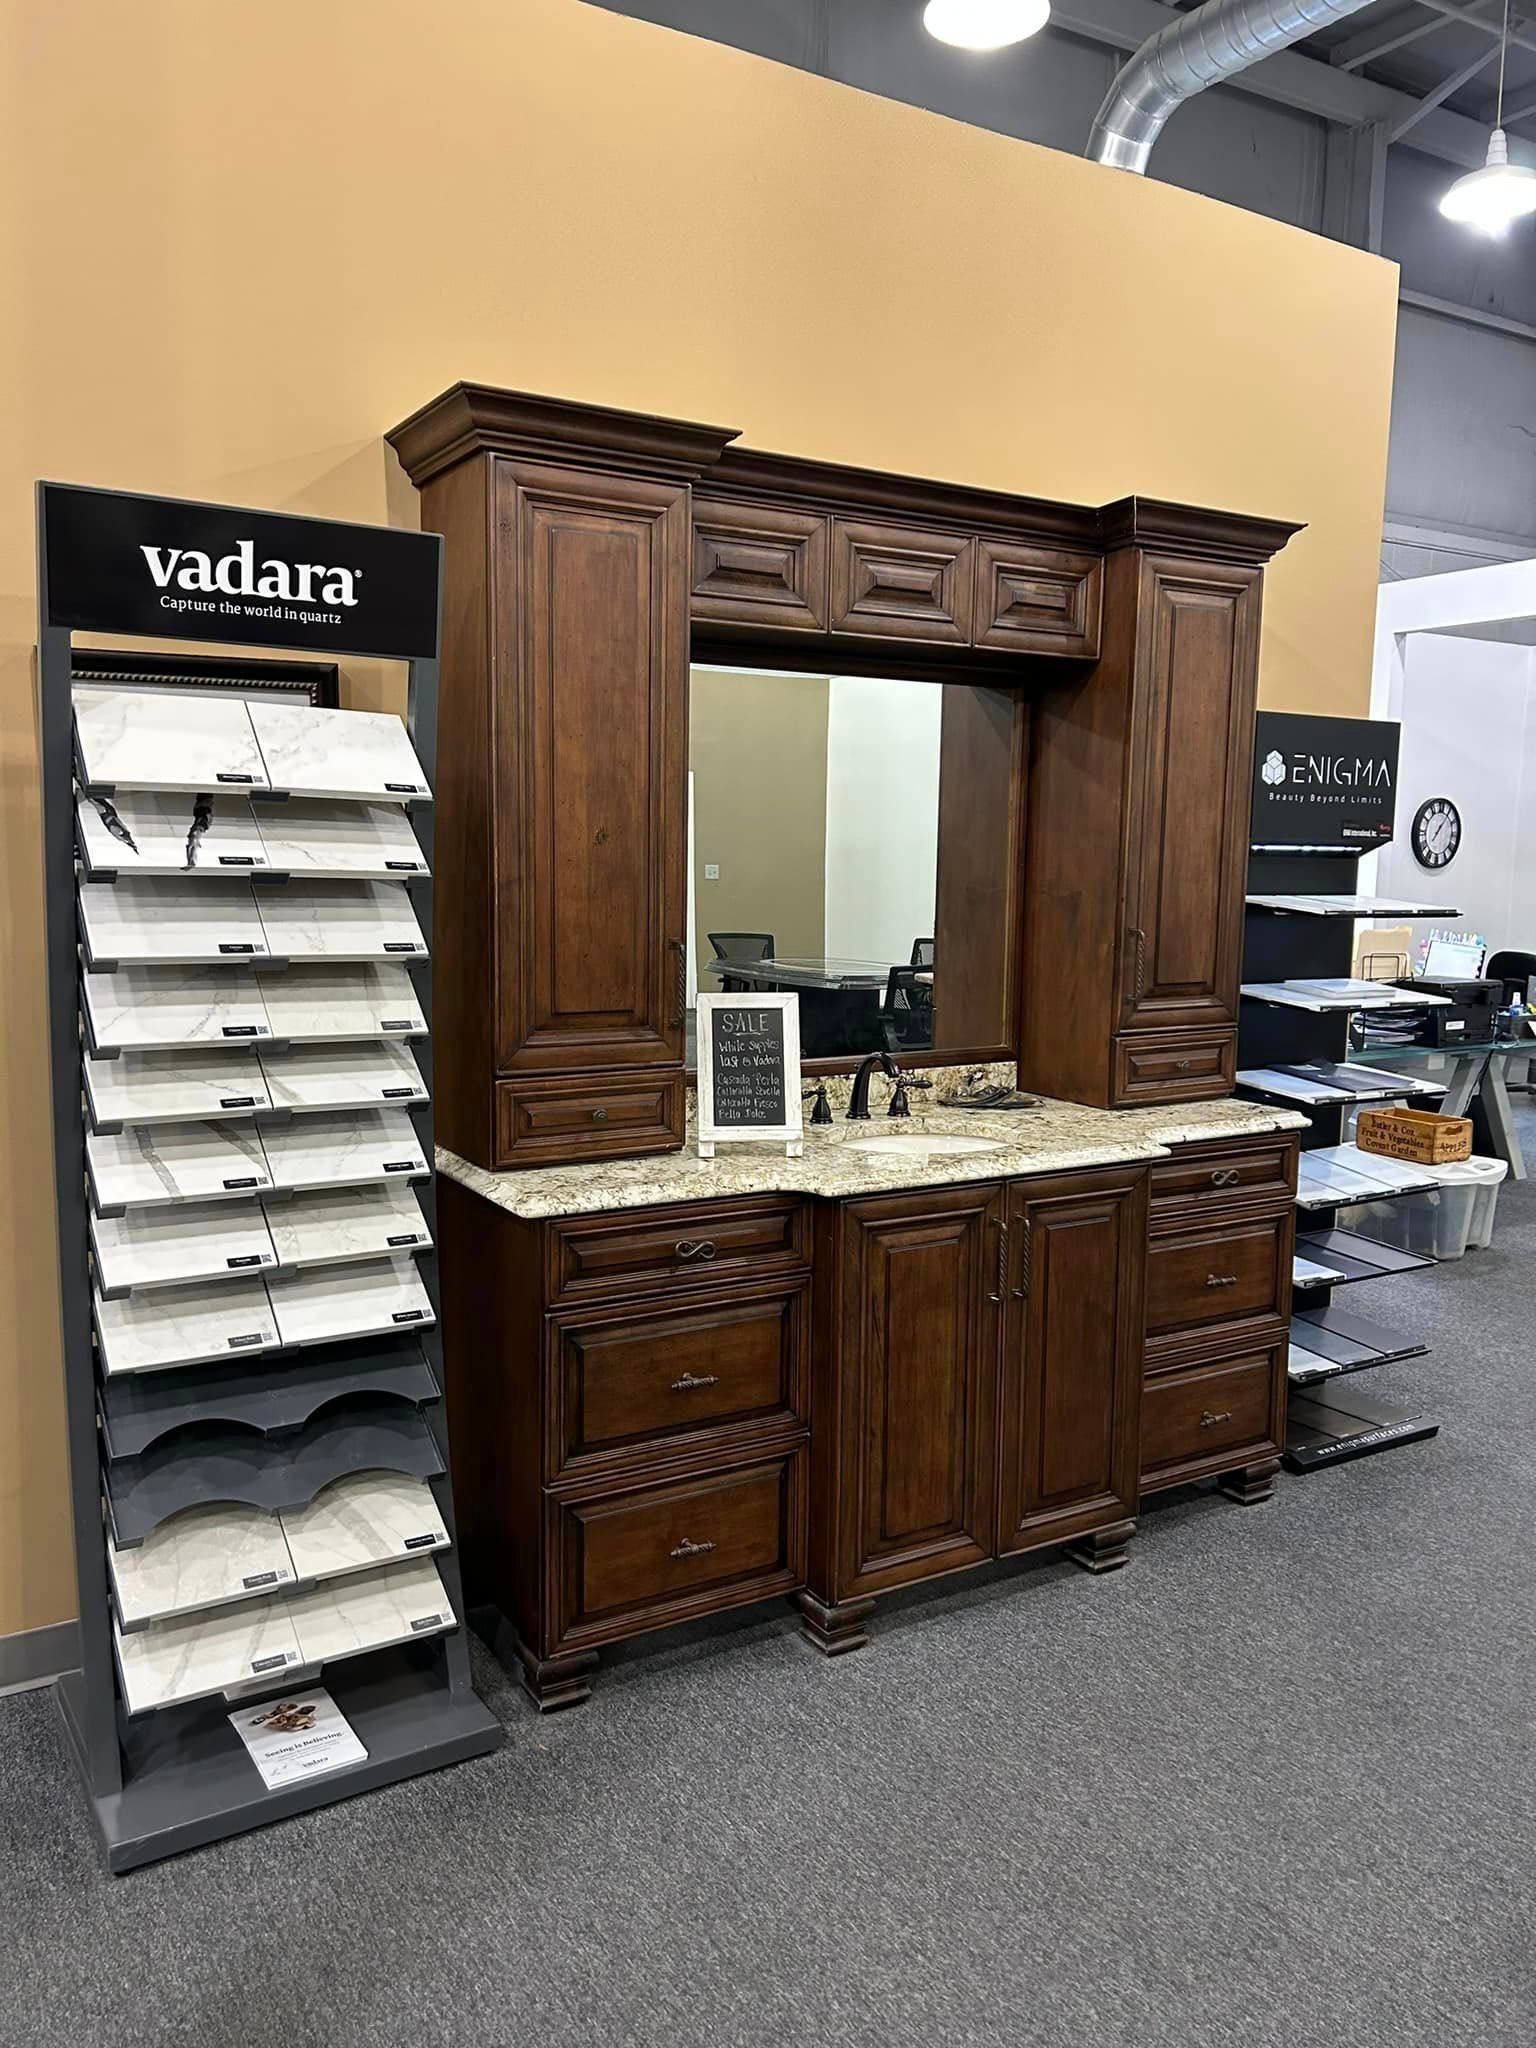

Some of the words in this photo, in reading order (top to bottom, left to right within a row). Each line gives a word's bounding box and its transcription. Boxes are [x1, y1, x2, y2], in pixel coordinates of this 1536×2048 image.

[160, 595, 216, 612] Capture
[219, 602, 241, 615] the
[244, 606, 282, 619] world
[284, 607, 298, 620] in
[299, 611, 342, 624] quartz
[1292, 754, 1391, 787] ENIGMA
[1269, 792, 1305, 803] Beauty
[1310, 794, 1346, 804] Beyond
[1351, 796, 1382, 804] Limits
[722, 1013, 769, 1032] SALE
[718, 1039, 745, 1052] While
